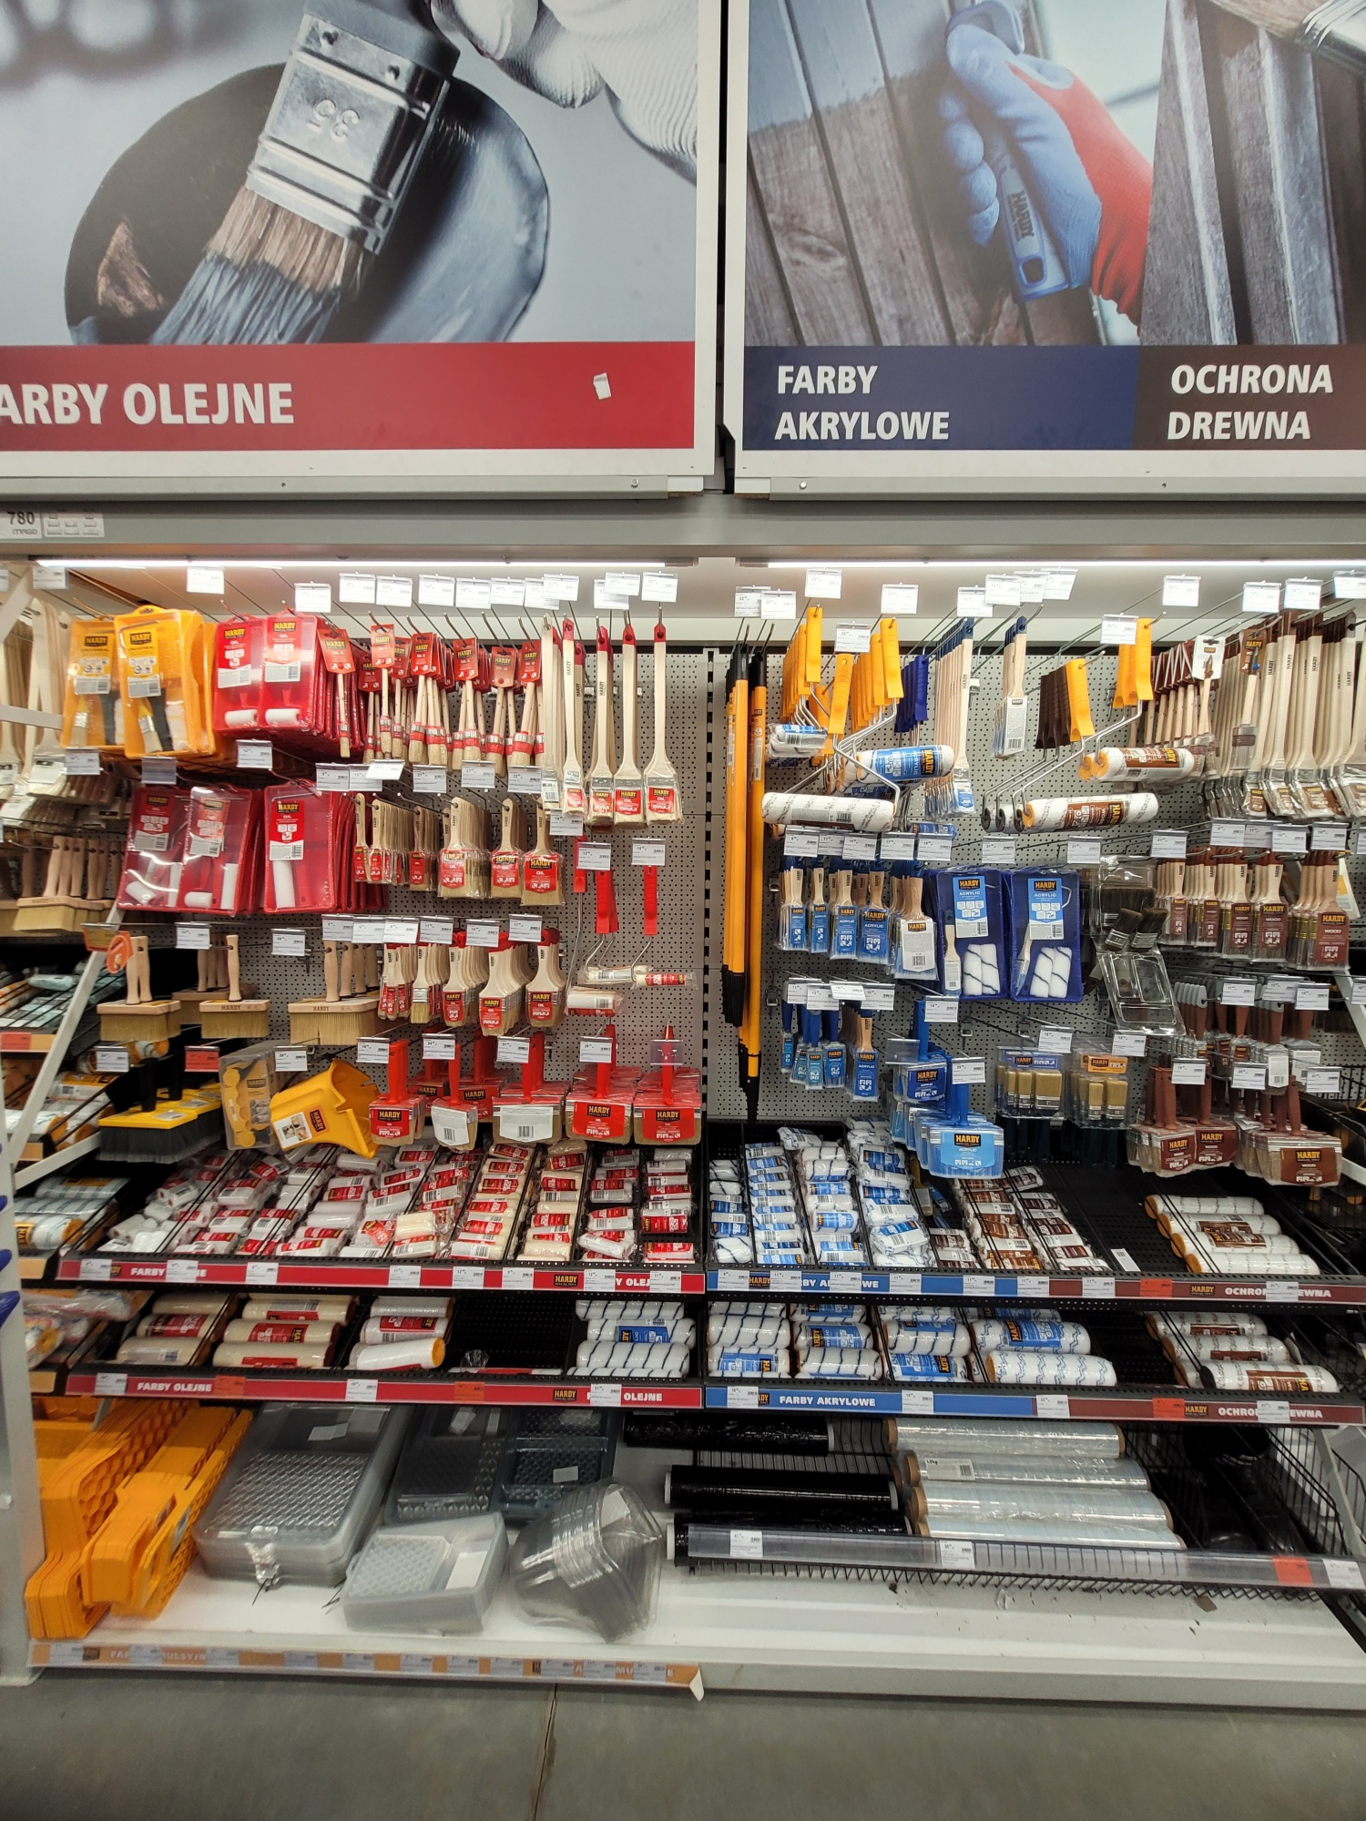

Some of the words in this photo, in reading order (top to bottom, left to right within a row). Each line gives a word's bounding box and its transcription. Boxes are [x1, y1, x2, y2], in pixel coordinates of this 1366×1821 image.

[777, 365, 878, 395] FARBY
[1170, 364, 1334, 395] OCHRONA
[0, 382, 108, 426] ARBY
[124, 382, 294, 426] OLEJNE
[774, 410, 950, 441] AKRYLOWE
[1167, 410, 1312, 441] DREWNA
[7, 511, 35, 525] 780
[273, 622, 296, 631] HARDY
[225, 628, 246, 638] HARDY
[924, 749, 934, 774] HARDY
[959, 879, 979, 888] HARDY
[1035, 882, 1056, 890] HARDY
[865, 911, 886, 920] HARDY
[1322, 915, 1346, 923] HARDY
[908, 923, 926, 931] HARDY
[532, 993, 551, 1001] HARDY
[1015, 1057, 1033, 1065] HARDY
[1092, 1058, 1109, 1067] HARDY
[917, 1071, 938, 1080] HARDY
[465, 1090, 485, 1099] HARDY
[588, 1106, 610, 1114] HARDY
[379, 1111, 401, 1119] HARDY
[955, 1134, 980, 1144] HARDY
[1201, 1132, 1224, 1141] HARDY
[1168, 1139, 1188, 1150] HARDY
[1296, 1151, 1320, 1159] HARDY
[130, 1267, 165, 1277] FARBY
[555, 1275, 577, 1283] HARDY
[749, 1276, 771, 1284] HARDY
[1190, 1285, 1214, 1294] HARDY
[1224, 1287, 1266, 1296] OCHRO
[1299, 1289, 1332, 1298] EWNA
[137, 1382, 170, 1391] FARBY
[173, 1383, 212, 1392] OLEJNE
[554, 1389, 577, 1398] HARDY
[623, 1392, 663, 1402] OLEJNE
[779, 1395, 813, 1405] FARBY
[817, 1396, 876, 1407] AKRYLOWE
[1185, 1405, 1208, 1413] HARDY
[1218, 1407, 1257, 1416] OCHRO
[1291, 1409, 1323, 1418] EWNA
